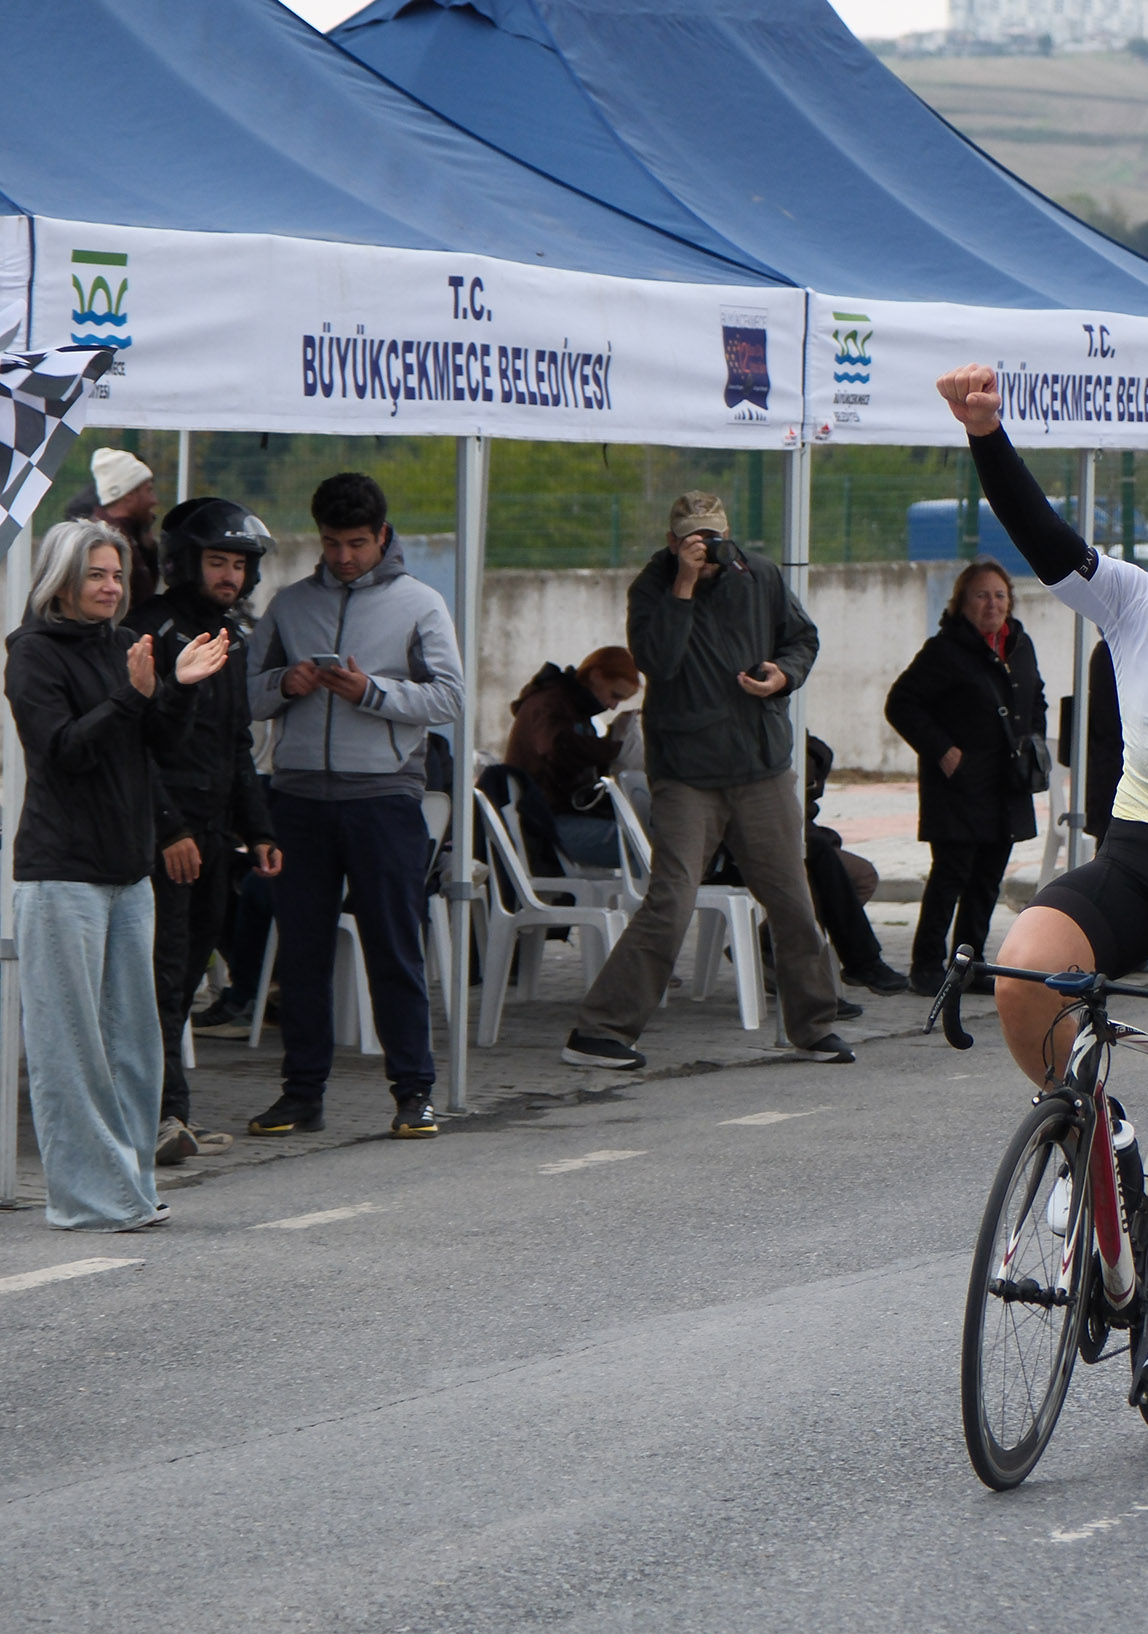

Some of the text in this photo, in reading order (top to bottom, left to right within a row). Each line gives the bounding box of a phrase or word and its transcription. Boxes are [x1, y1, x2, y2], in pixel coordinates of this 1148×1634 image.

[448, 275, 493, 322] T.C.
[302, 322, 612, 417] BÜYÜKÇEKMECE BELEDİYESİ
[1083, 324, 1116, 358] T.C.
[996, 361, 1113, 434] ÜYÜKÇEKMECE
